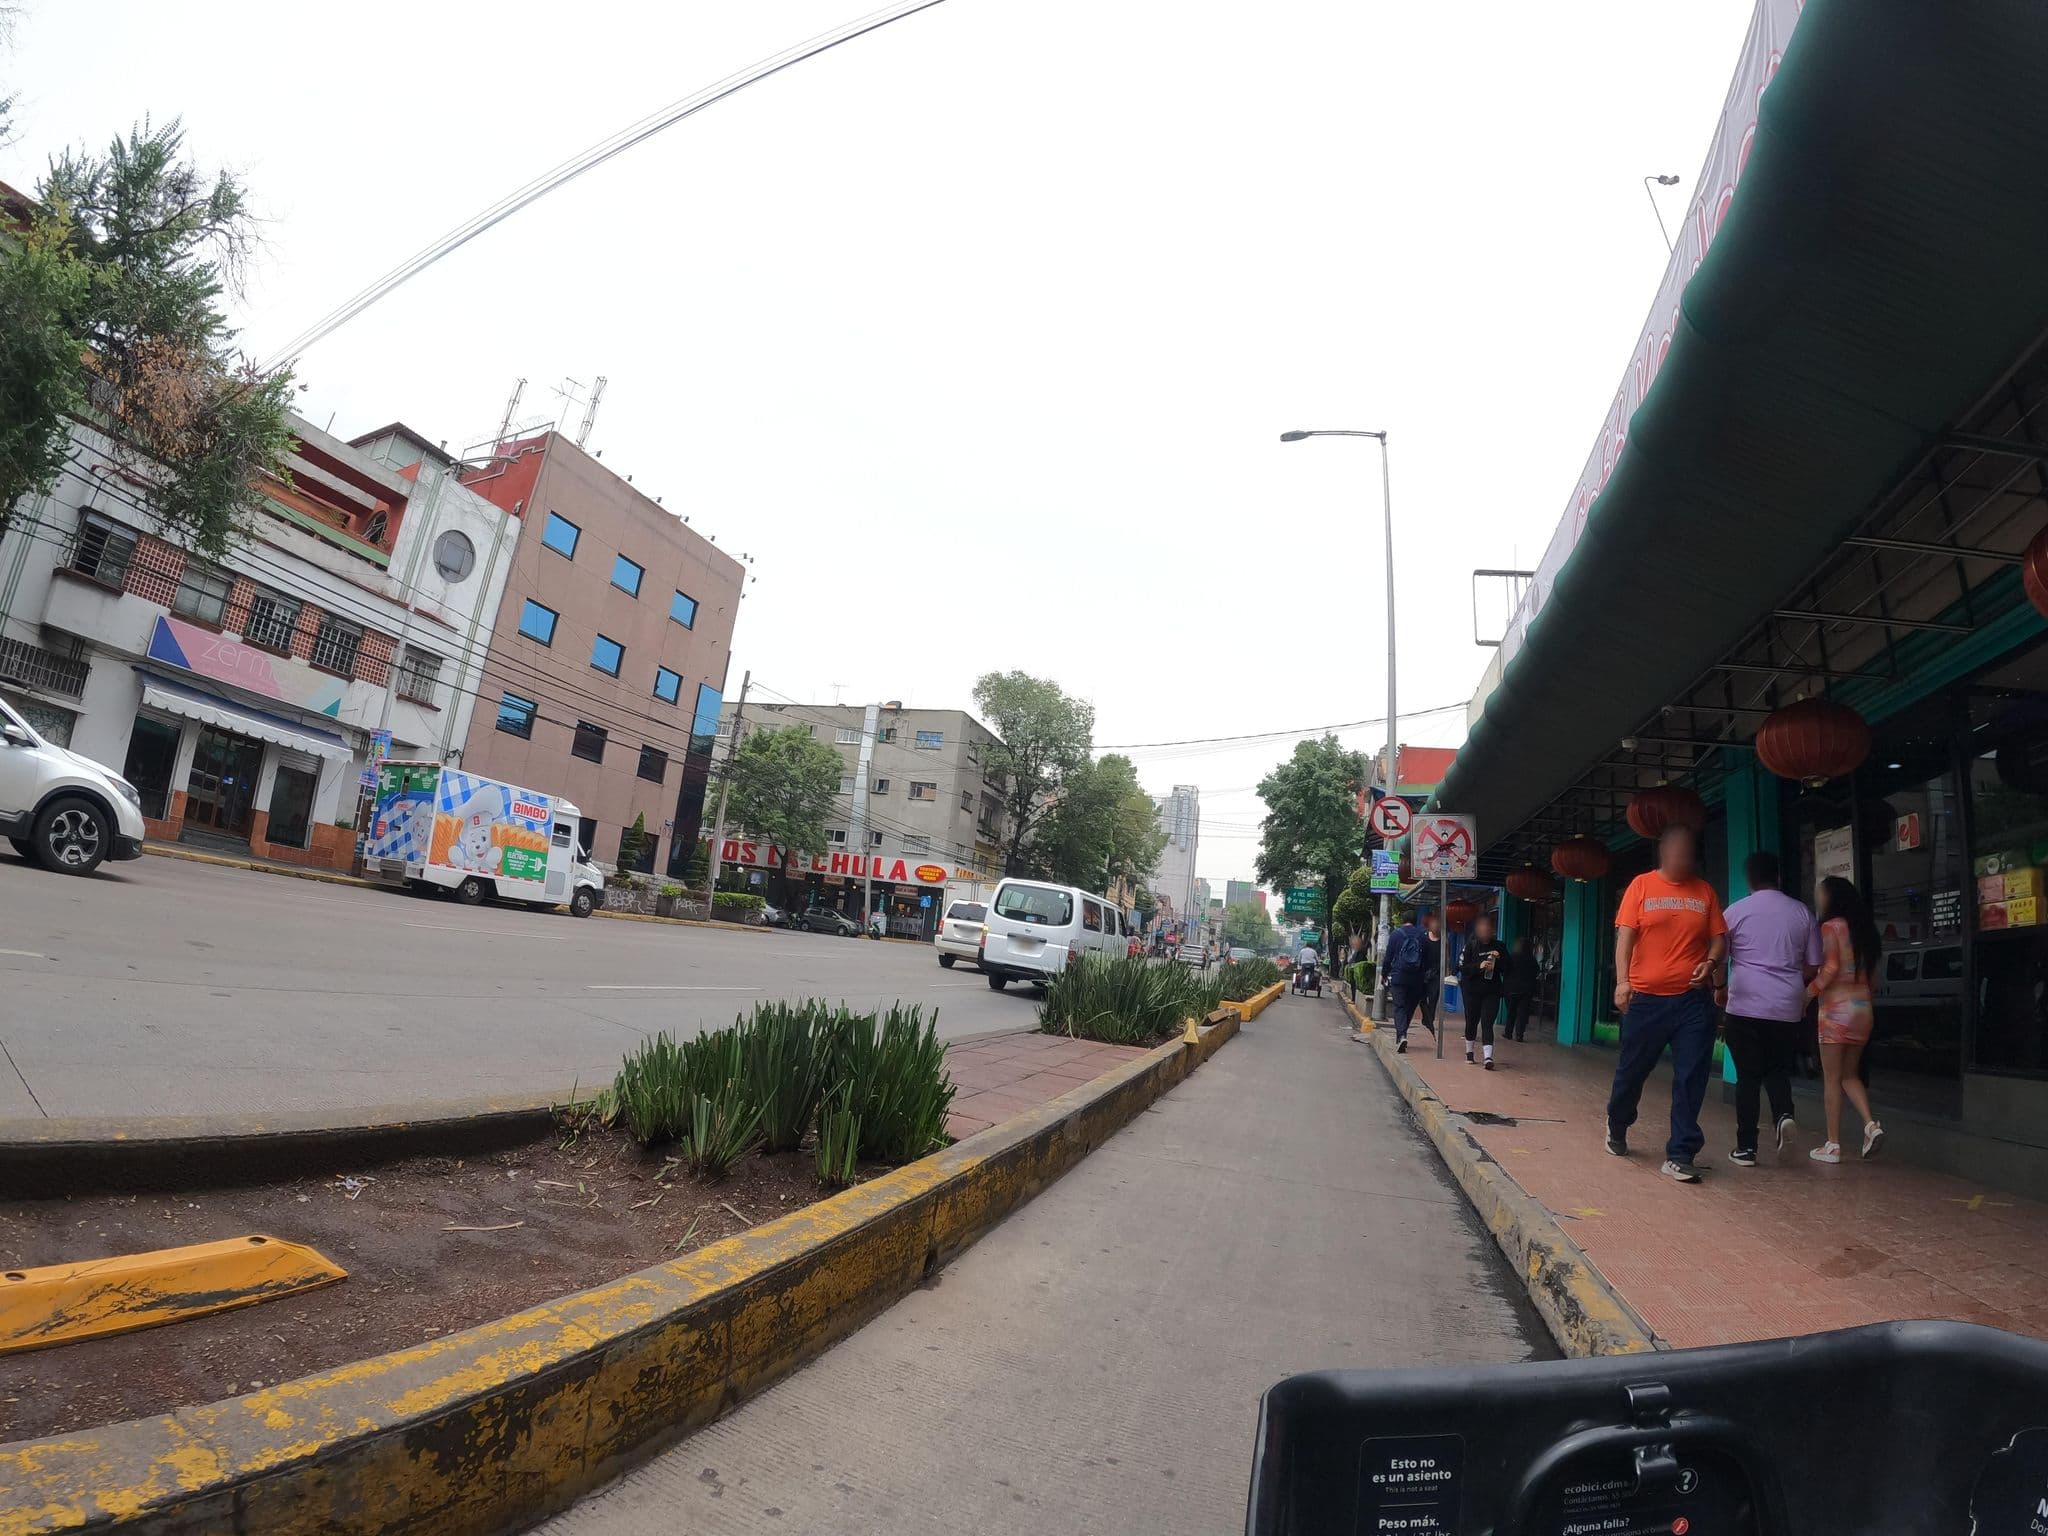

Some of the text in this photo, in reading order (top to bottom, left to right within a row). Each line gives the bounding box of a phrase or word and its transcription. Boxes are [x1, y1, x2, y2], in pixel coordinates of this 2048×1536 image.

[512, 802, 547, 820] BIMBO
[811, 852, 909, 881] CHULA
[1391, 1459, 1435, 1470] Esto no
[1372, 1470, 1452, 1483] es un asiento
[1385, 1486, 1399, 1494] This
[1564, 1479, 1628, 1495] ecobici.cdm
[1378, 1515, 1440, 1529] Peso máx.
[1562, 1517, 1631, 1536] ¿Alguna falla?
